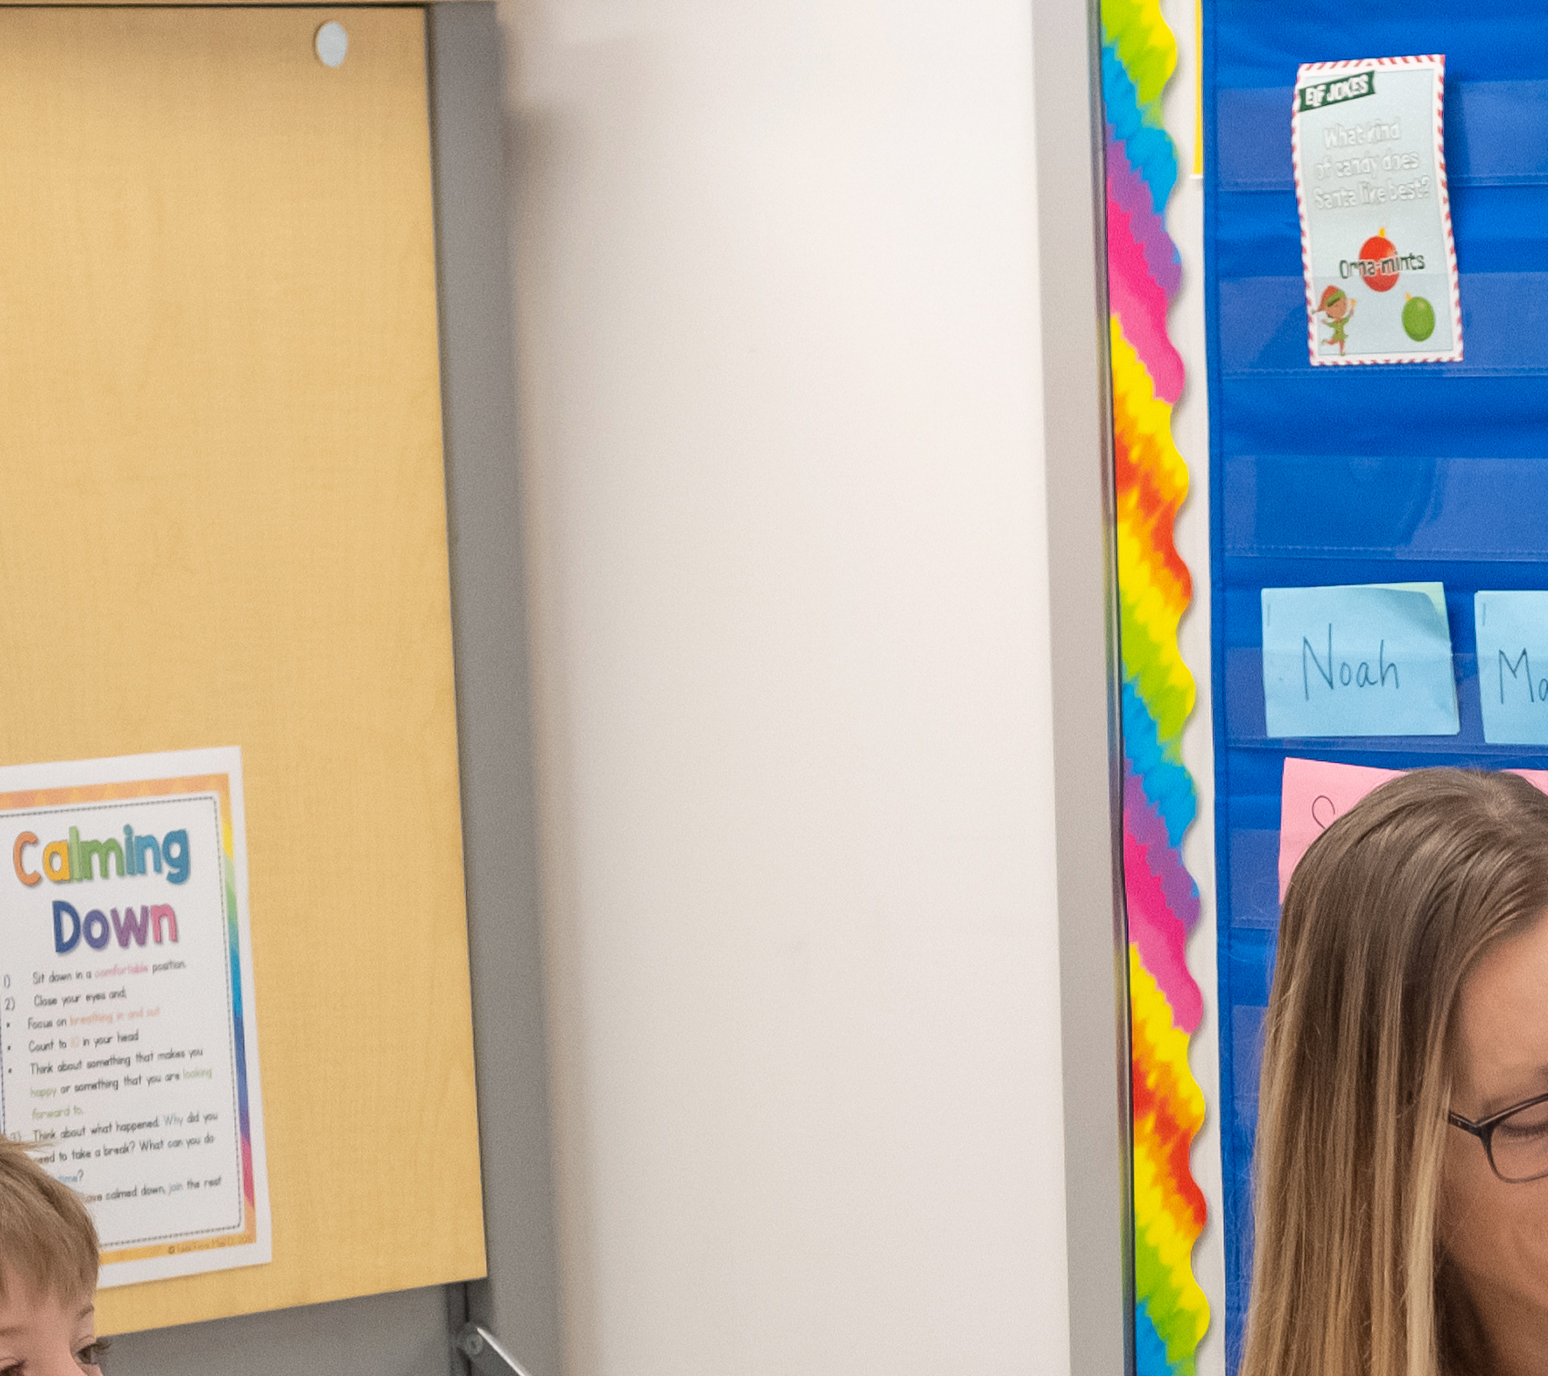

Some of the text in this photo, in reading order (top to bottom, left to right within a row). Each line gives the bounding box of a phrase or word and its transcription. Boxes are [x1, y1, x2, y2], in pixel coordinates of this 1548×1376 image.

[1328, 74, 1369, 101] JOKES
[1324, 118, 1401, 148] What kind
[1316, 148, 1419, 179] of candy does
[1315, 177, 1430, 209] Santa like best?
[1339, 253, 1425, 279] Orna-mints
[1303, 622, 1399, 701] Noah
[13, 824, 190, 886] Calming
[52, 900, 178, 955] Down
[30, 1047, 203, 1075] Think about something that makes you
